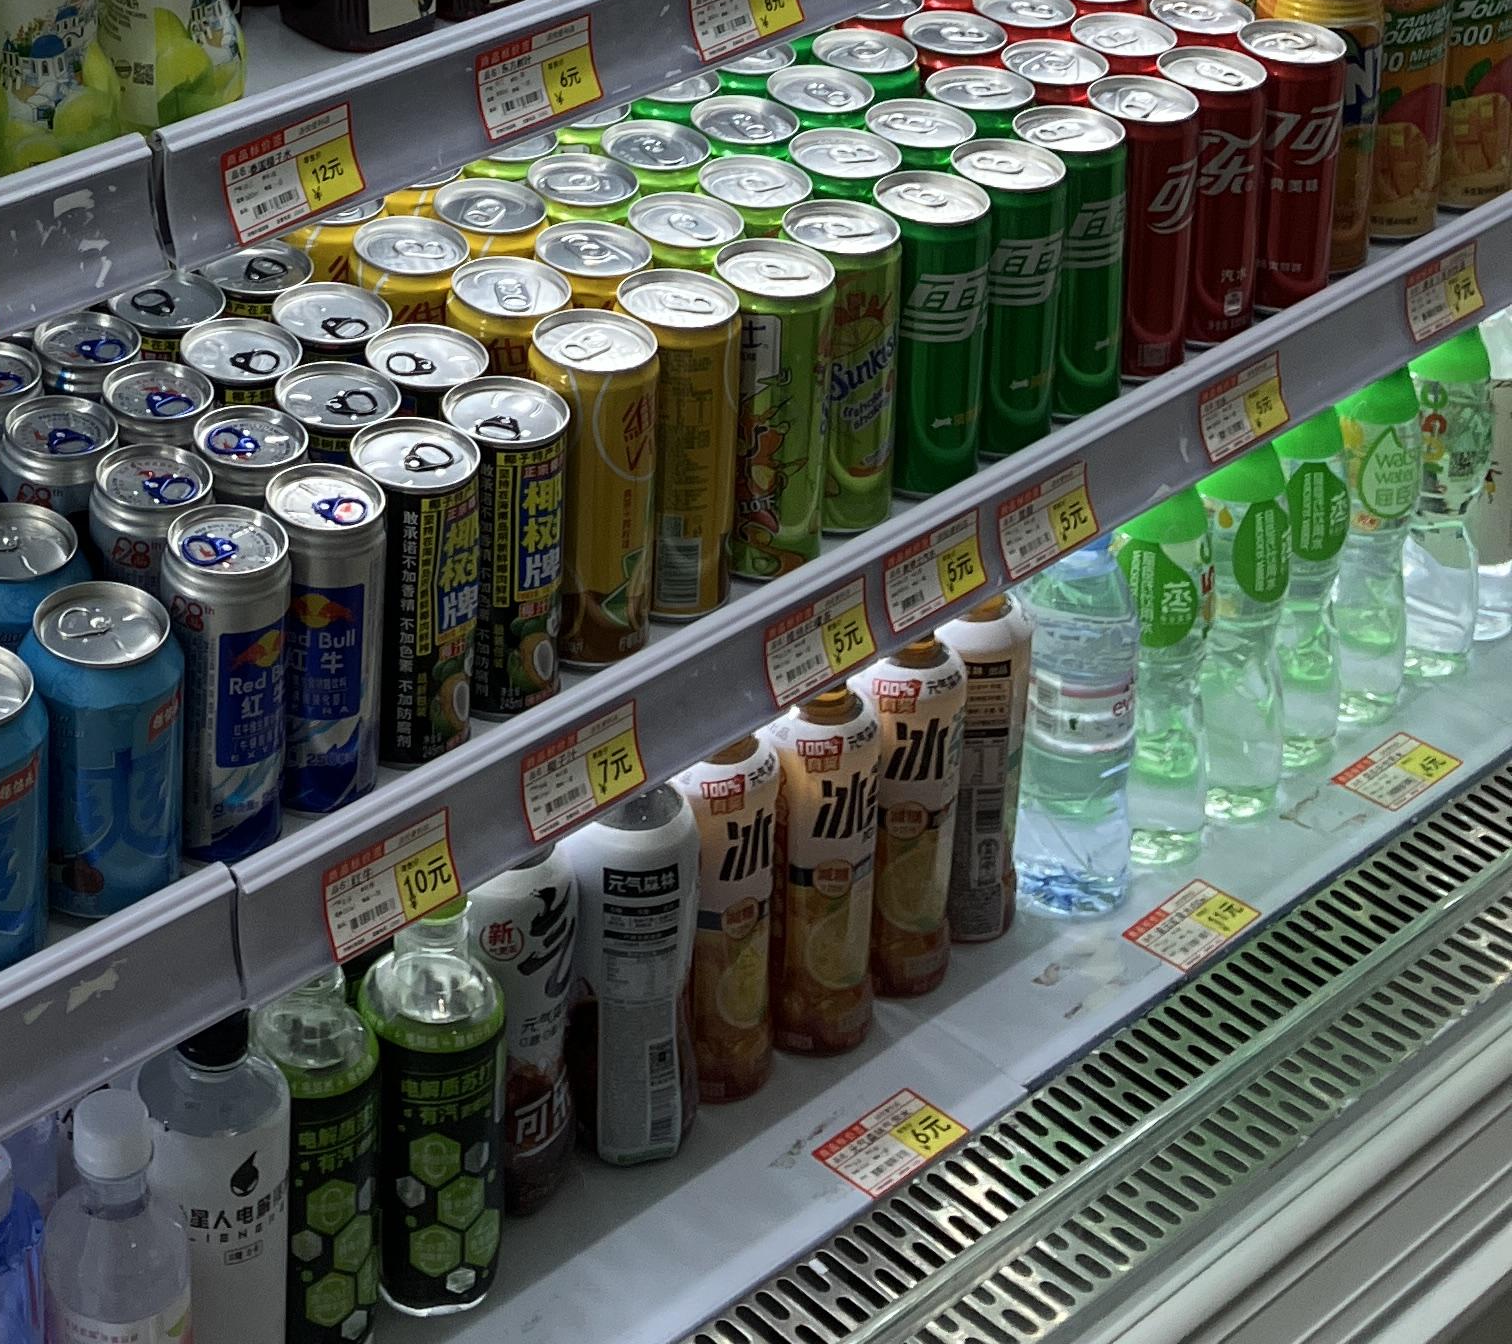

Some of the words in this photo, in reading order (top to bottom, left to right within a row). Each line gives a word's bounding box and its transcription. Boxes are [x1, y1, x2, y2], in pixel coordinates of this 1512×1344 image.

[559, 67, 581, 88] 6元
[312, 158, 345, 183] 12元
[1059, 501, 1088, 532] 5元
[947, 551, 973, 582] 5元
[318, 629, 356, 650] Bull
[833, 622, 863, 652] 5元
[229, 673, 267, 696] Red
[598, 748, 633, 785] 7元
[403, 856, 452, 898] 10元
[608, 871, 677, 893] 元气森林
[488, 920, 514, 947] 新
[911, 1115, 950, 1143] 6元
